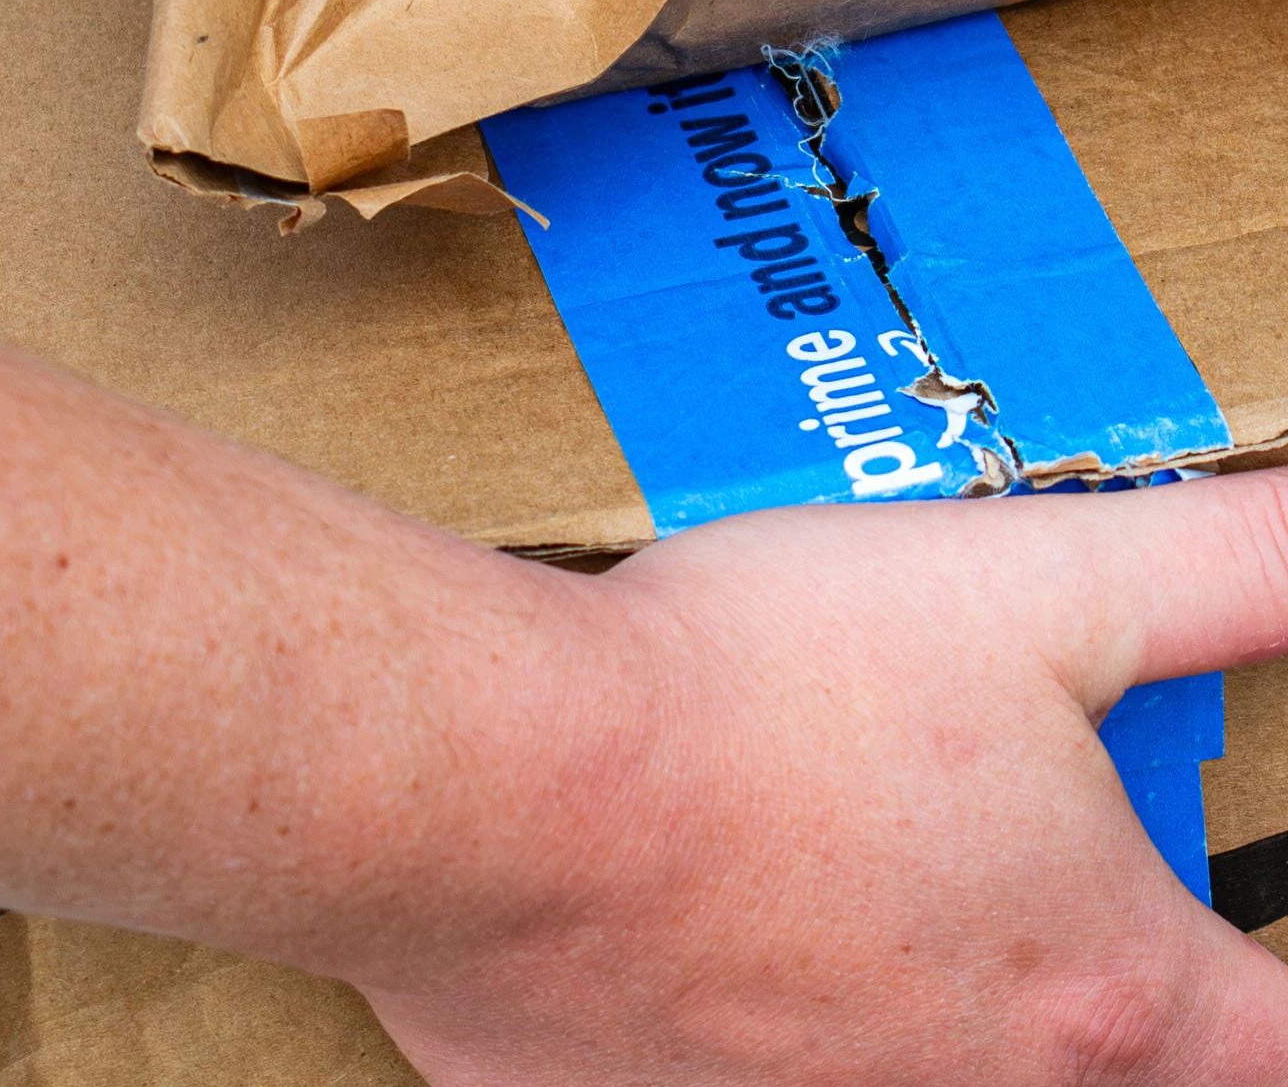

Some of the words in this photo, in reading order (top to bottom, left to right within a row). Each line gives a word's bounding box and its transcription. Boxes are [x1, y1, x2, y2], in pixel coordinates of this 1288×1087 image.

[679, 114, 791, 222] now
[715, 222, 842, 321] and
[786, 329, 944, 496] prime
